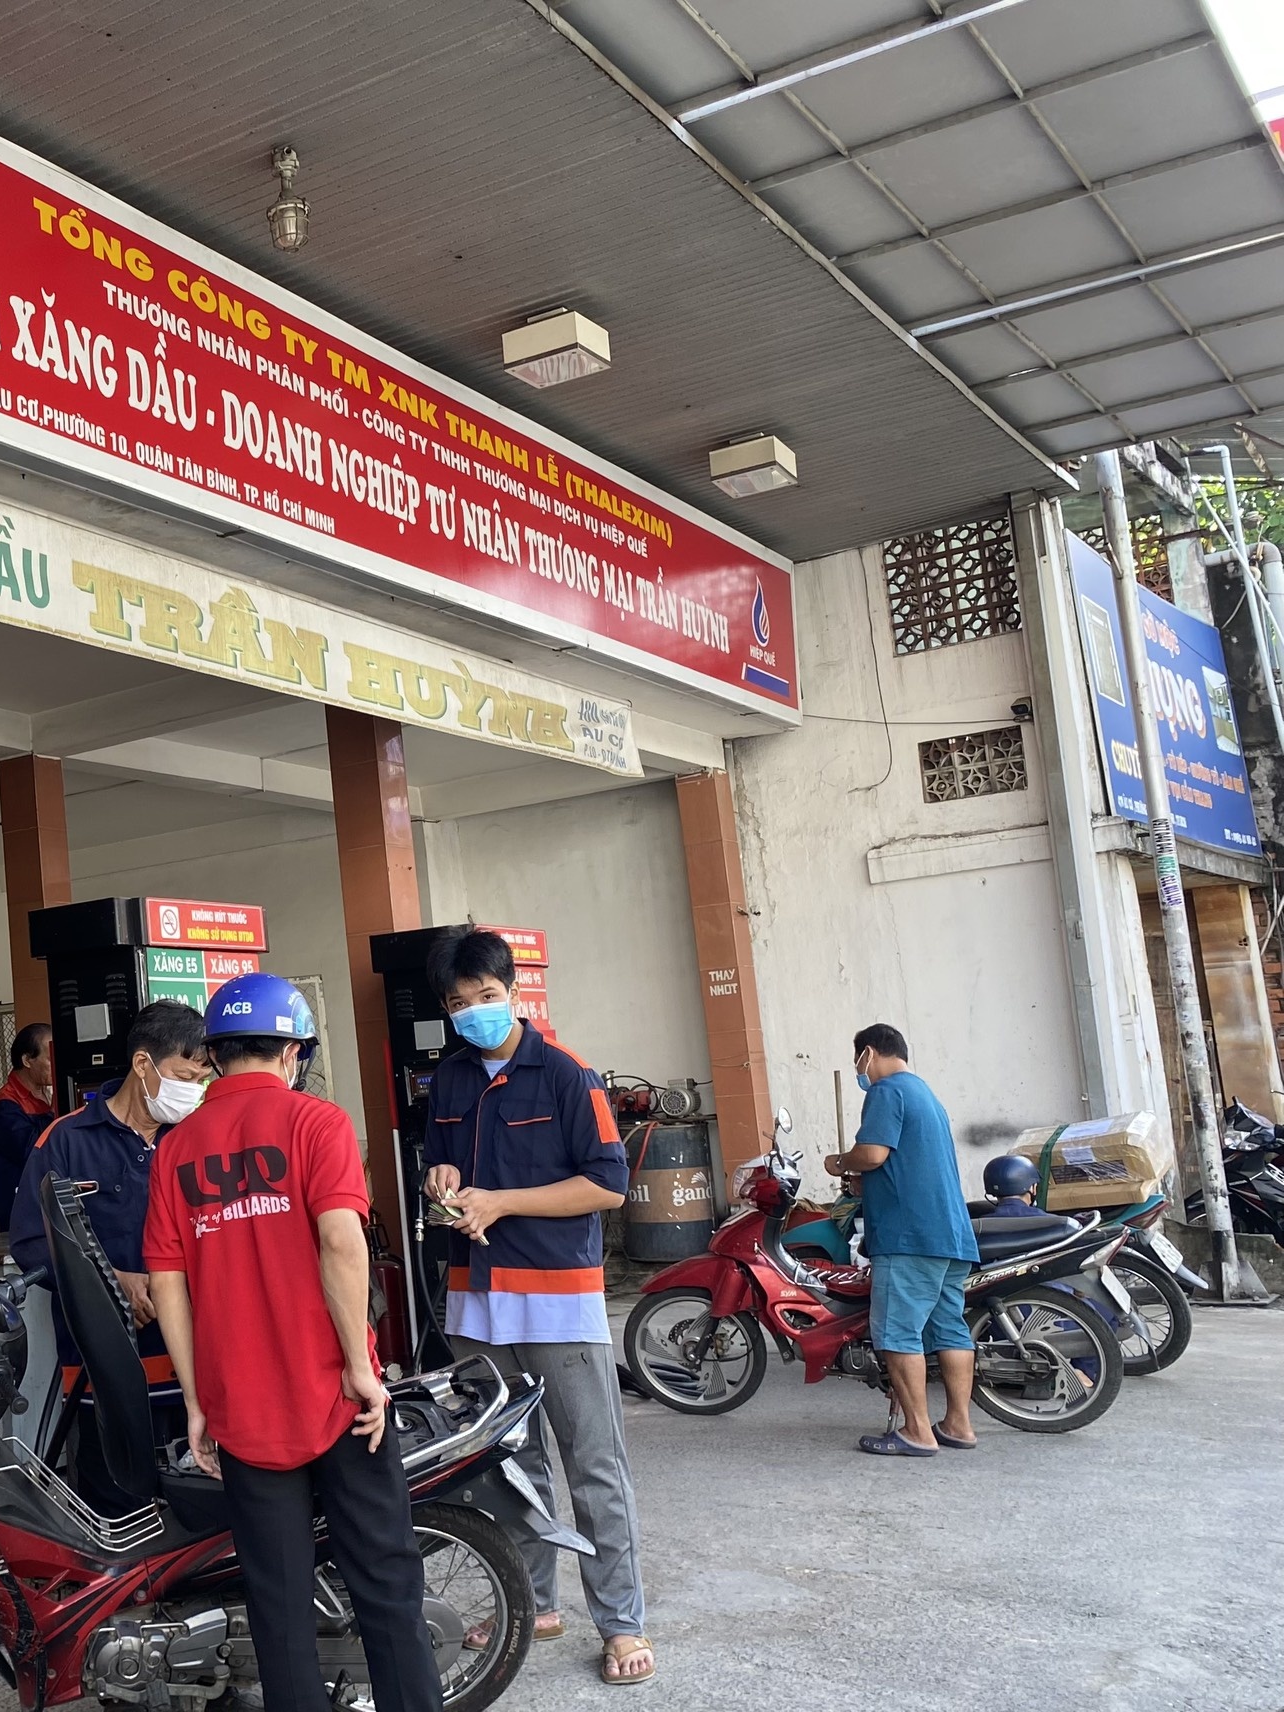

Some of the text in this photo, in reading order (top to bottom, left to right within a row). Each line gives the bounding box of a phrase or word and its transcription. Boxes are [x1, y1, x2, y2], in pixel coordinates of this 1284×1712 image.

[33, 196, 672, 548] TỔNG CÔNG TY TM XNK THANH LỄ (THALEXIM)
[103, 280, 648, 558] THƯƠNG NHÂN PHÂN PHỐI CÔNG TY TNHH THƯƠNG MẠI DỊCH VỤ HIỆP QUẾ
[9, 286, 118, 399] XĂNG
[126, 332, 197, 432] DẦU
[221, 389, 325, 486] DOANH
[328, 438, 421, 535] NGHIỆP
[425, 482, 456, 541] TƯ
[460, 498, 522, 568] NHÂN
[601, 559, 635, 622] MẠI
[635, 565, 679, 633] TRẦN
[680, 595, 731, 655] HUỲNH
[110, 431, 132, 460] 10,
[136, 441, 174, 473] QUẬN
[176, 456, 204, 485] TÂN
[206, 467, 241, 501] BÌNH,
[243, 483, 261, 506] TP.
[263, 489, 280, 513] HỒ
[283, 498, 302, 522] CHÍ
[305, 506, 336, 535] MINH
[71, 559, 329, 692] TRẦN
[343, 642, 575, 753] HUỲNH
[154, 952, 254, 974] XĂNG E5 XĂNG 95
[709, 968, 735, 982] THAY
[222, 1002, 252, 1016] ACB
[629, 1184, 650, 1202] oil
[508, 1620, 520, 1654] KENDA
